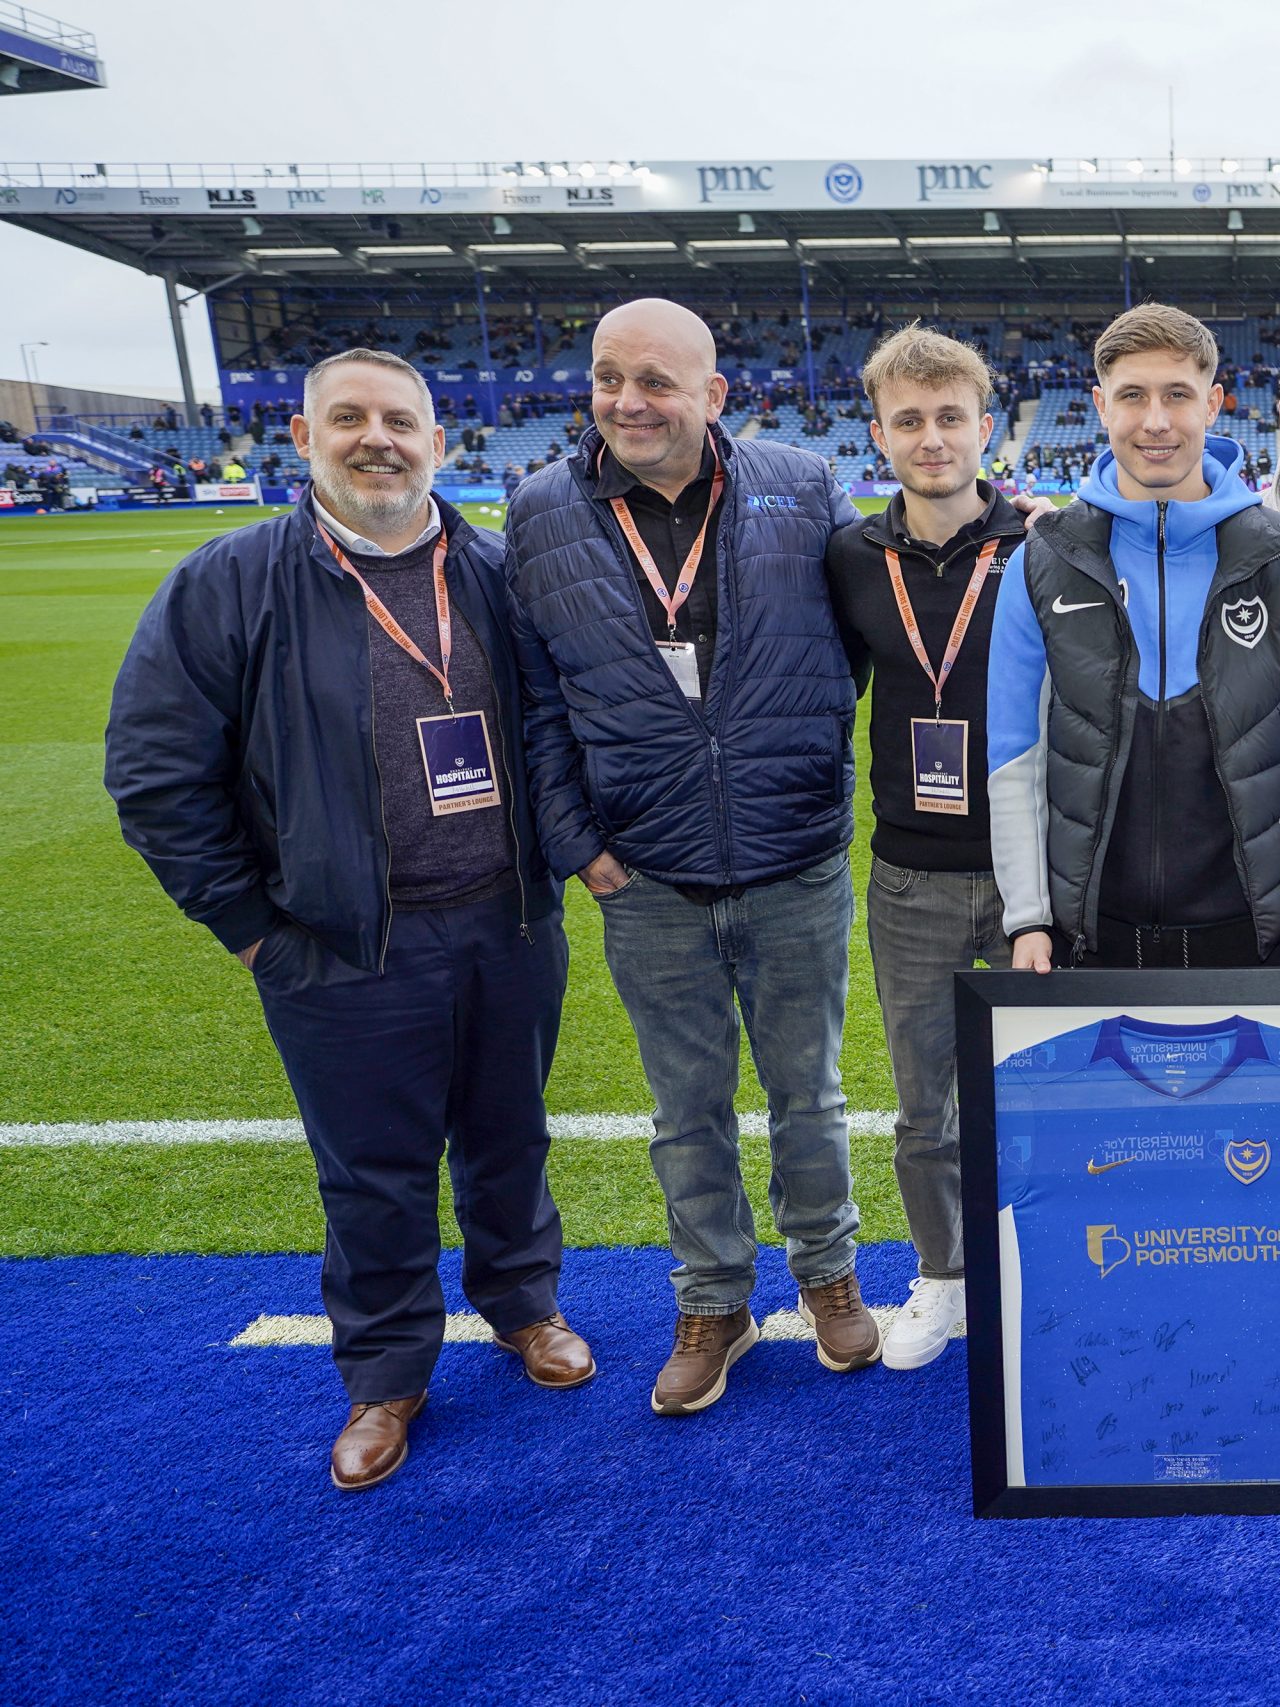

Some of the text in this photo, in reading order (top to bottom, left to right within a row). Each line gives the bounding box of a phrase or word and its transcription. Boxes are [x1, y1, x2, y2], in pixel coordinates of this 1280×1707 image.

[697, 165, 775, 203] pmc
[916, 163, 993, 202] pmc
[1226, 182, 1264, 202] pmc
[287, 189, 326, 209] pmc
[629, 531, 645, 553] LOUNGE
[894, 575, 907, 605] PARTNERS
[902, 604, 915, 628] LOUNGE
[367, 598, 412, 649] PARTNERS LOUNGE
[951, 617, 966, 648] PARTNERS
[961, 594, 976, 617] LOUNGE
[435, 768, 487, 785] HOSPITALITY
[919, 773, 960, 785] HOSPITALITY
[438, 795, 494, 811] PARTNER'S LOUNGE
[919, 800, 943, 809] PARTNER'S
[1134, 1226, 1267, 1247] UNIVERSITY
